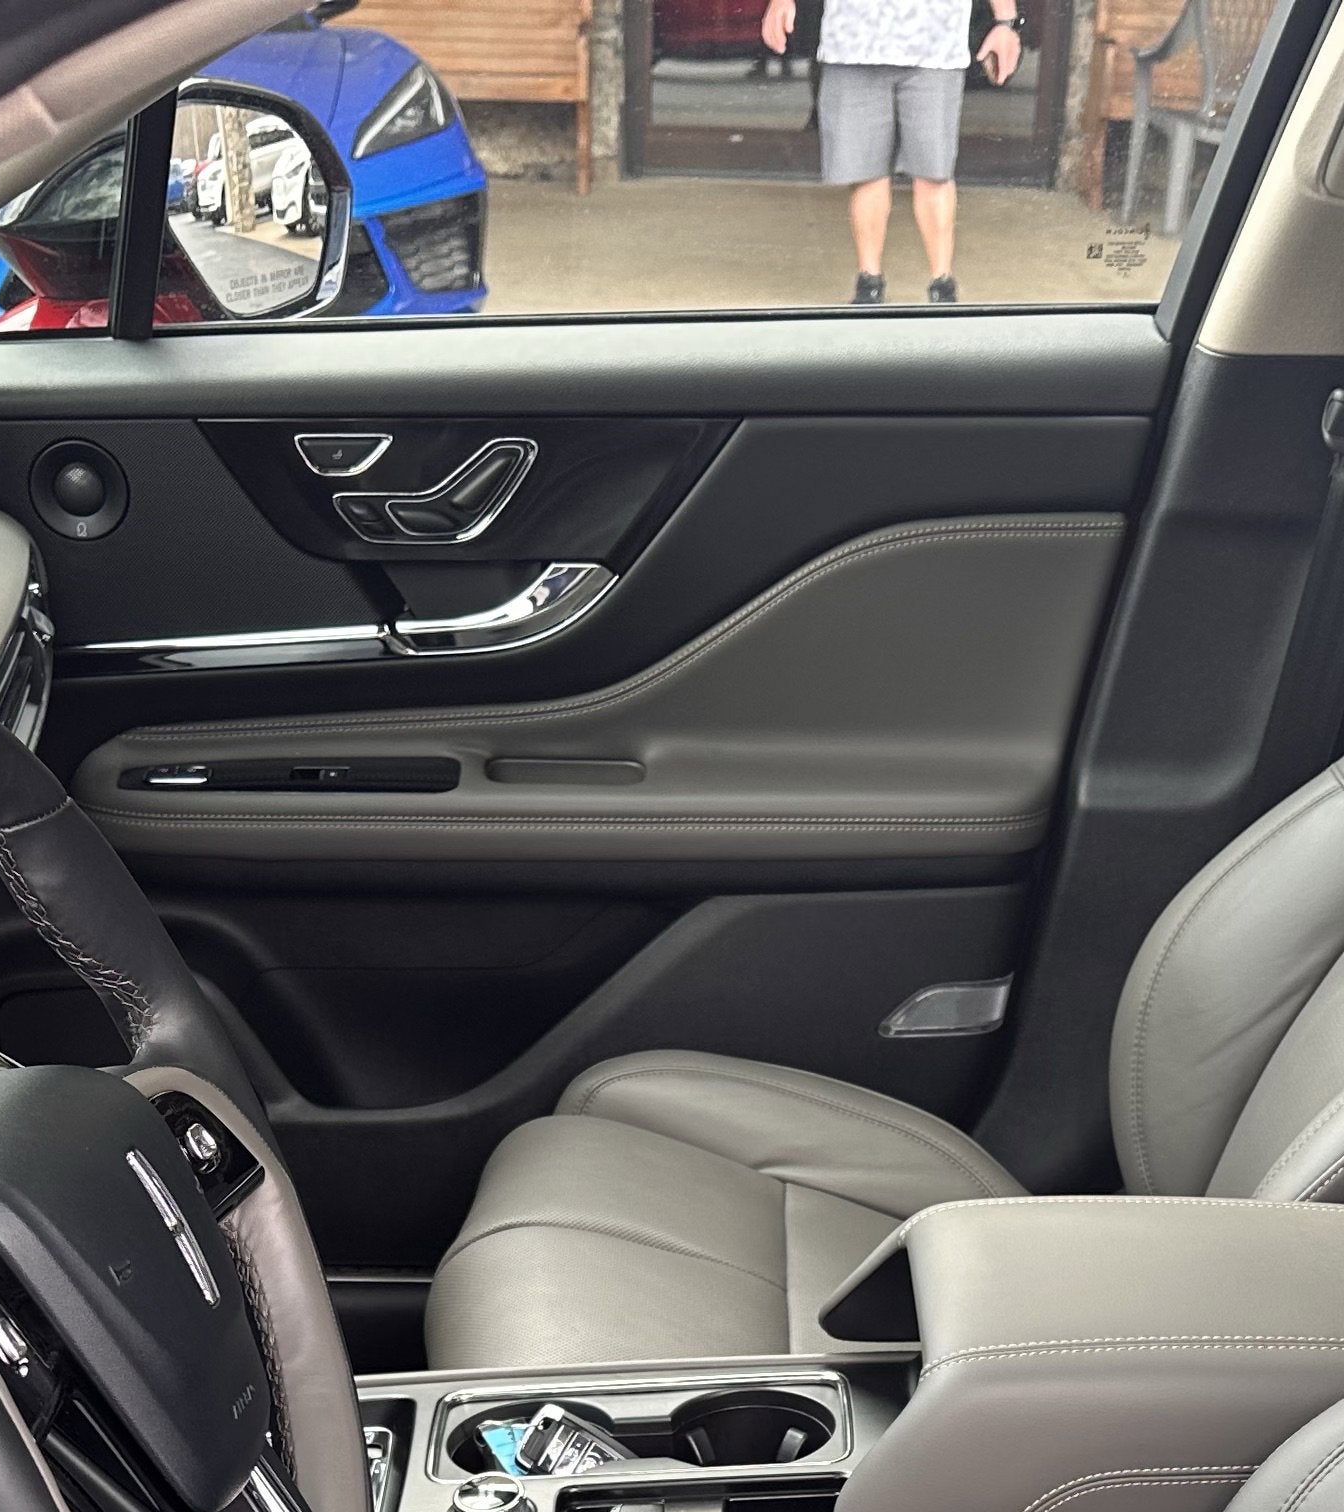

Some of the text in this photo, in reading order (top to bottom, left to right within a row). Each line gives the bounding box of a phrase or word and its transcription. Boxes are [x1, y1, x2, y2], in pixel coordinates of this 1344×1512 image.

[226, 277, 308, 303] CLOSER THAN THEY APPEAR
[230, 265, 304, 290] OBJECTS IN MIRROR ARE
